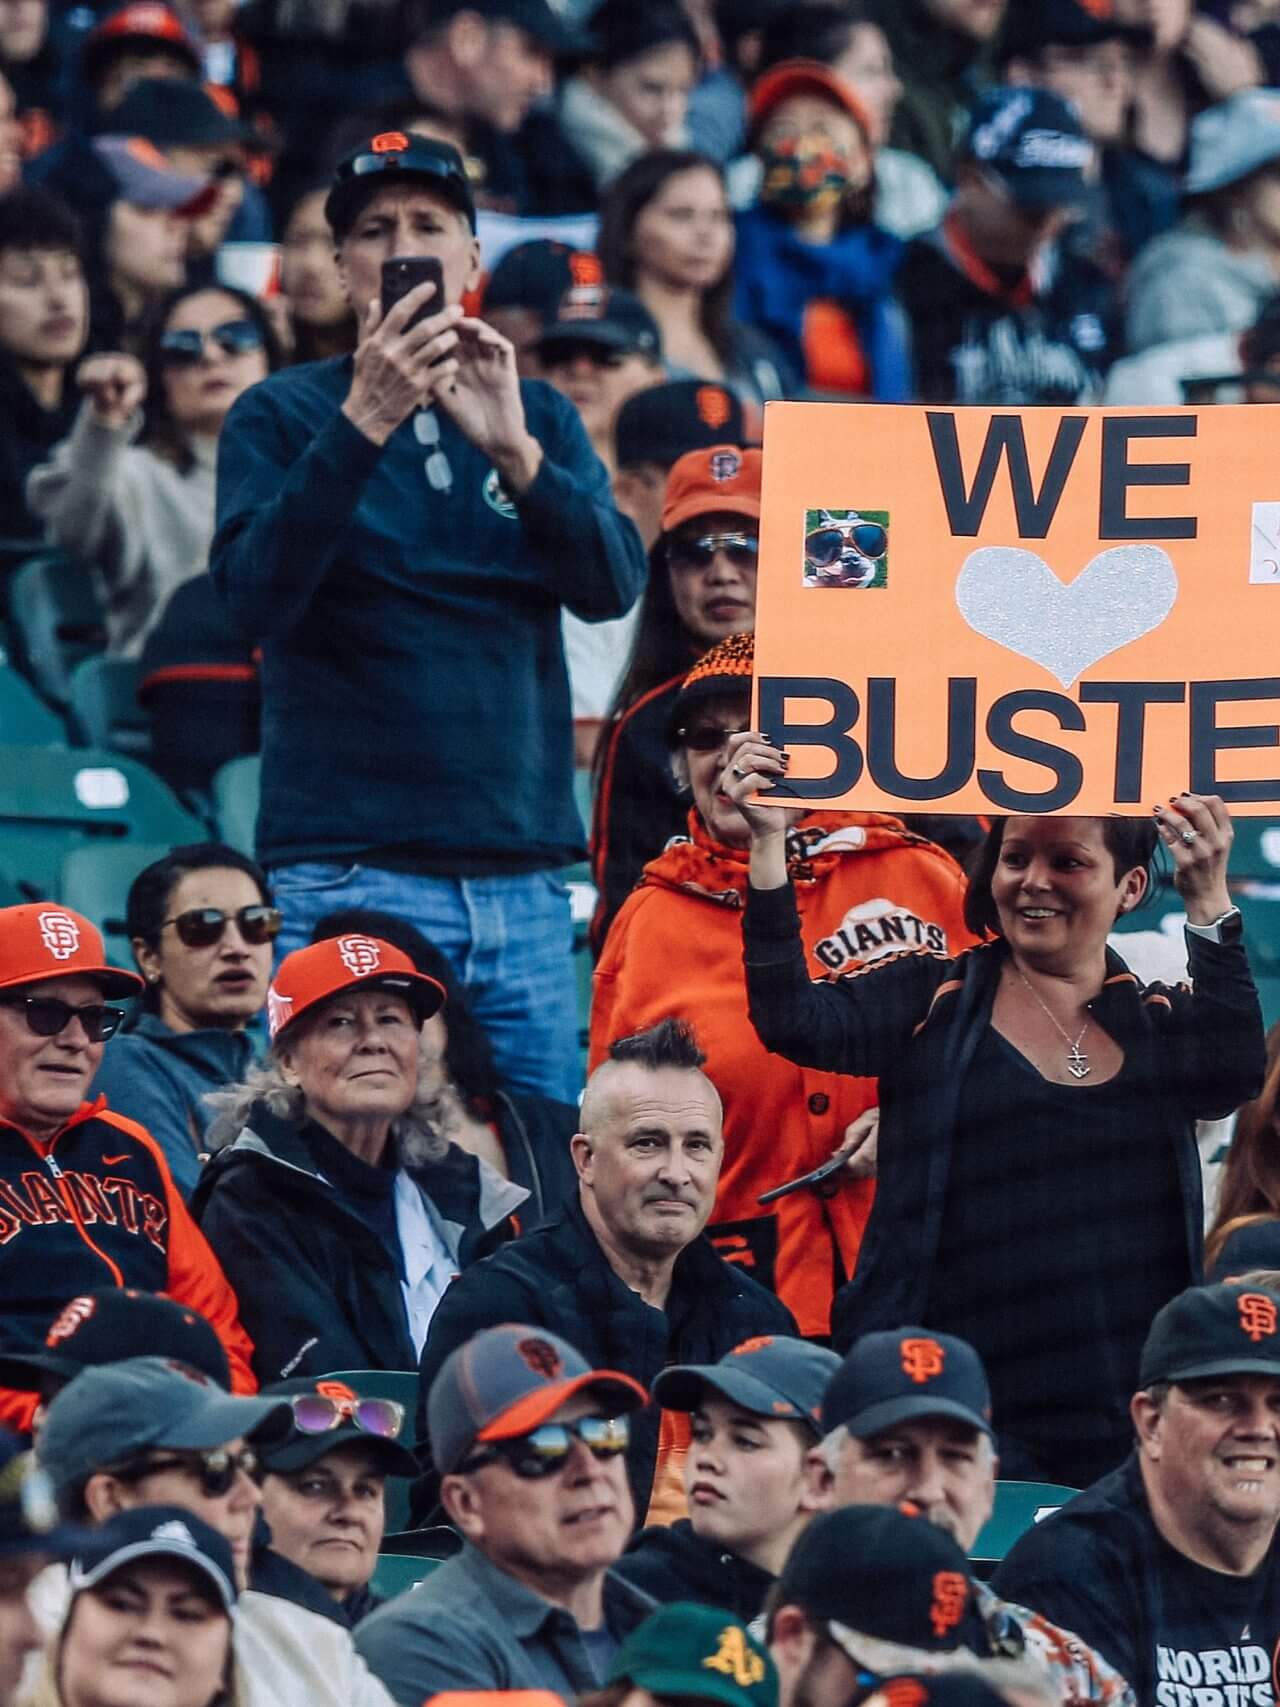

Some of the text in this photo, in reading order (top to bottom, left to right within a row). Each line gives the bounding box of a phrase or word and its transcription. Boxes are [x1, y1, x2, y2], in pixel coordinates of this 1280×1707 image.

[925, 412, 1198, 539] WE
[815, 914, 945, 969] GIANTS
[1238, 1293, 1278, 1342] SF
